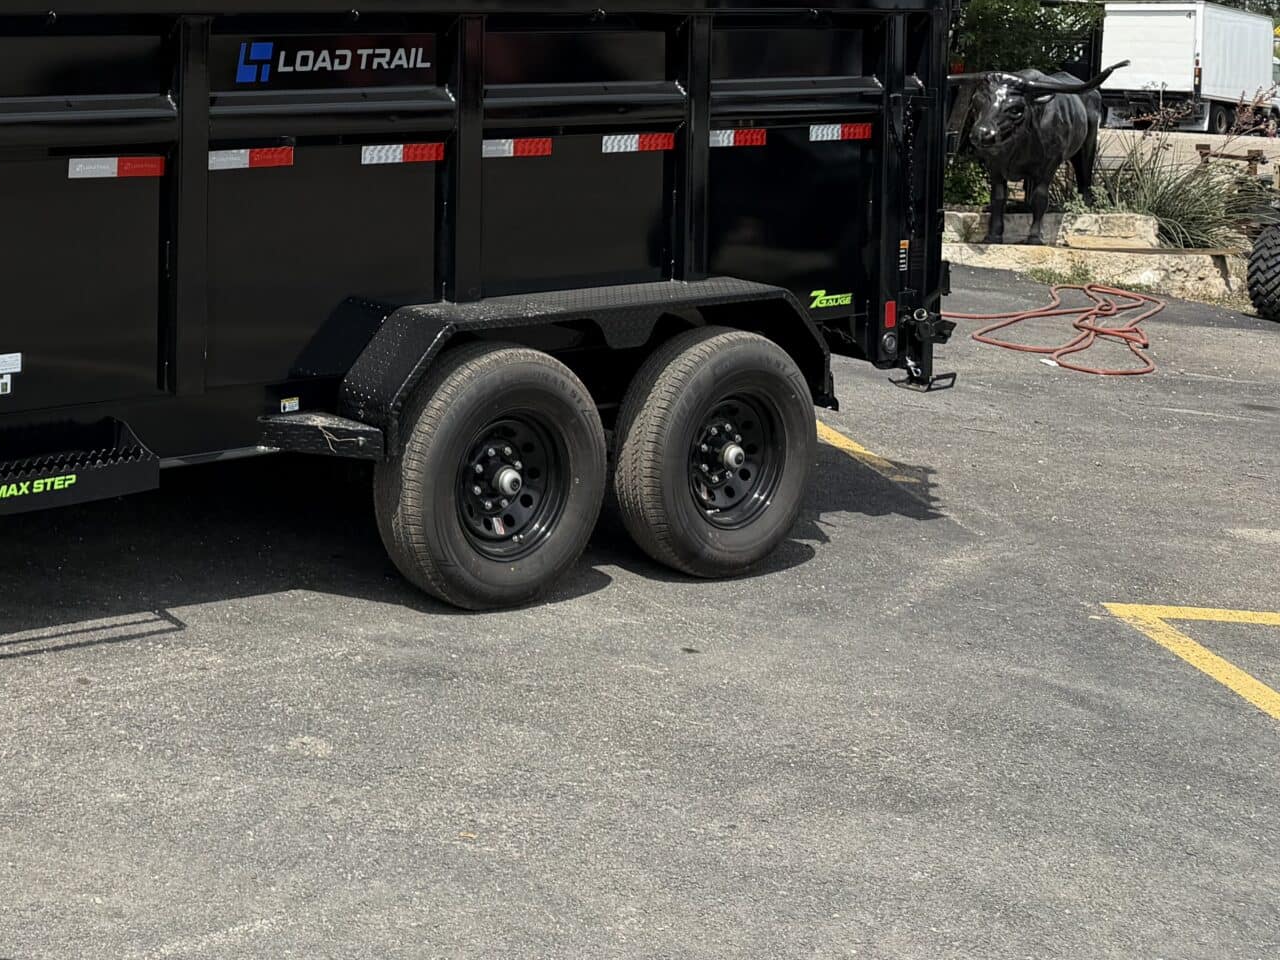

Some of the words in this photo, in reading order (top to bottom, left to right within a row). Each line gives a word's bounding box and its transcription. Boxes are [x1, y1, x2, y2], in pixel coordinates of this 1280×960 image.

[277, 49, 352, 72] LOAD
[357, 47, 431, 69] TRAIL
[32, 474, 77, 493] STEP
